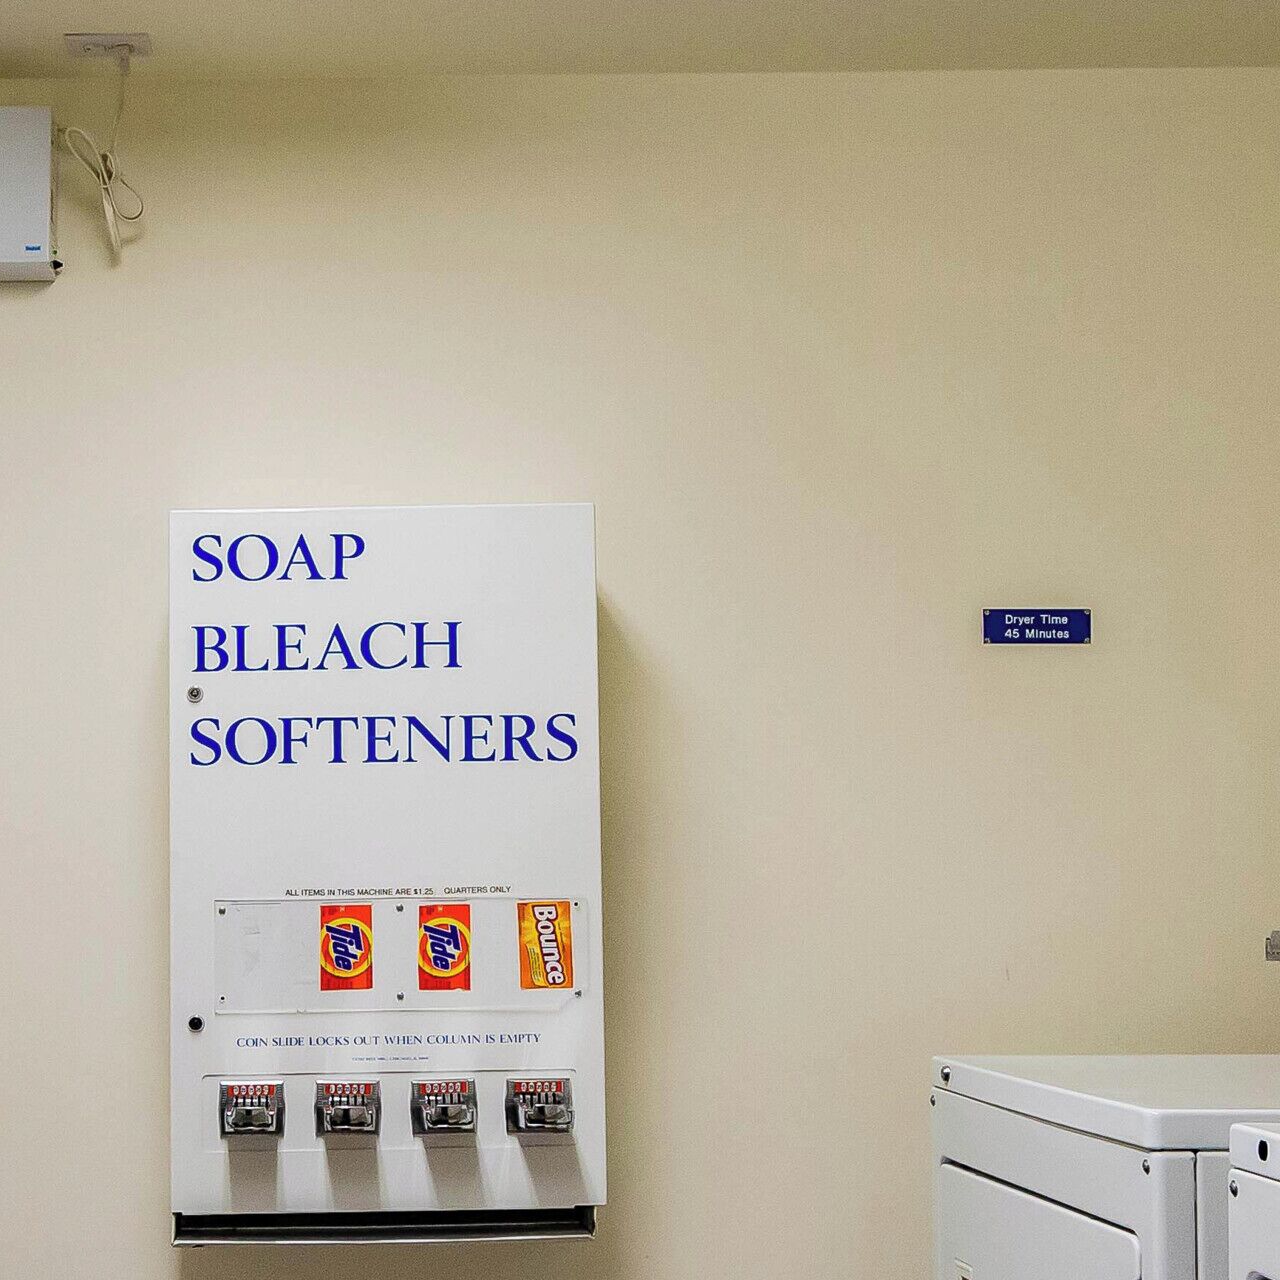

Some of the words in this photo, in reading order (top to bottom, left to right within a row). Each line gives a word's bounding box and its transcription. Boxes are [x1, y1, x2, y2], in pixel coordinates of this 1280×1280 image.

[191, 533, 365, 582] SOAP
[1004, 629, 1020, 639] 45
[1025, 628, 1069, 639] Minutes
[1005, 614, 1035, 626] Dryer
[1040, 614, 1068, 624] Time
[191, 621, 462, 673] BLEACH
[189, 713, 578, 766] SOFTENERS
[357, 888, 393, 896] MACHINE
[444, 886, 487, 894] QUARTERS
[324, 923, 364, 972] Tide
[422, 923, 462, 972] Tide
[531, 905, 566, 985] Bounce
[236, 1037, 268, 1047] COIN
[271, 1036, 305, 1047] SLIDE
[309, 1036, 350, 1046] LOCKS
[353, 1035, 380, 1046] OUT
[384, 1035, 422, 1045] WHEN
[426, 1034, 480, 1044] COLUMN
[486, 1034, 496, 1044] IS
[500, 1033, 542, 1044] EMPTY
